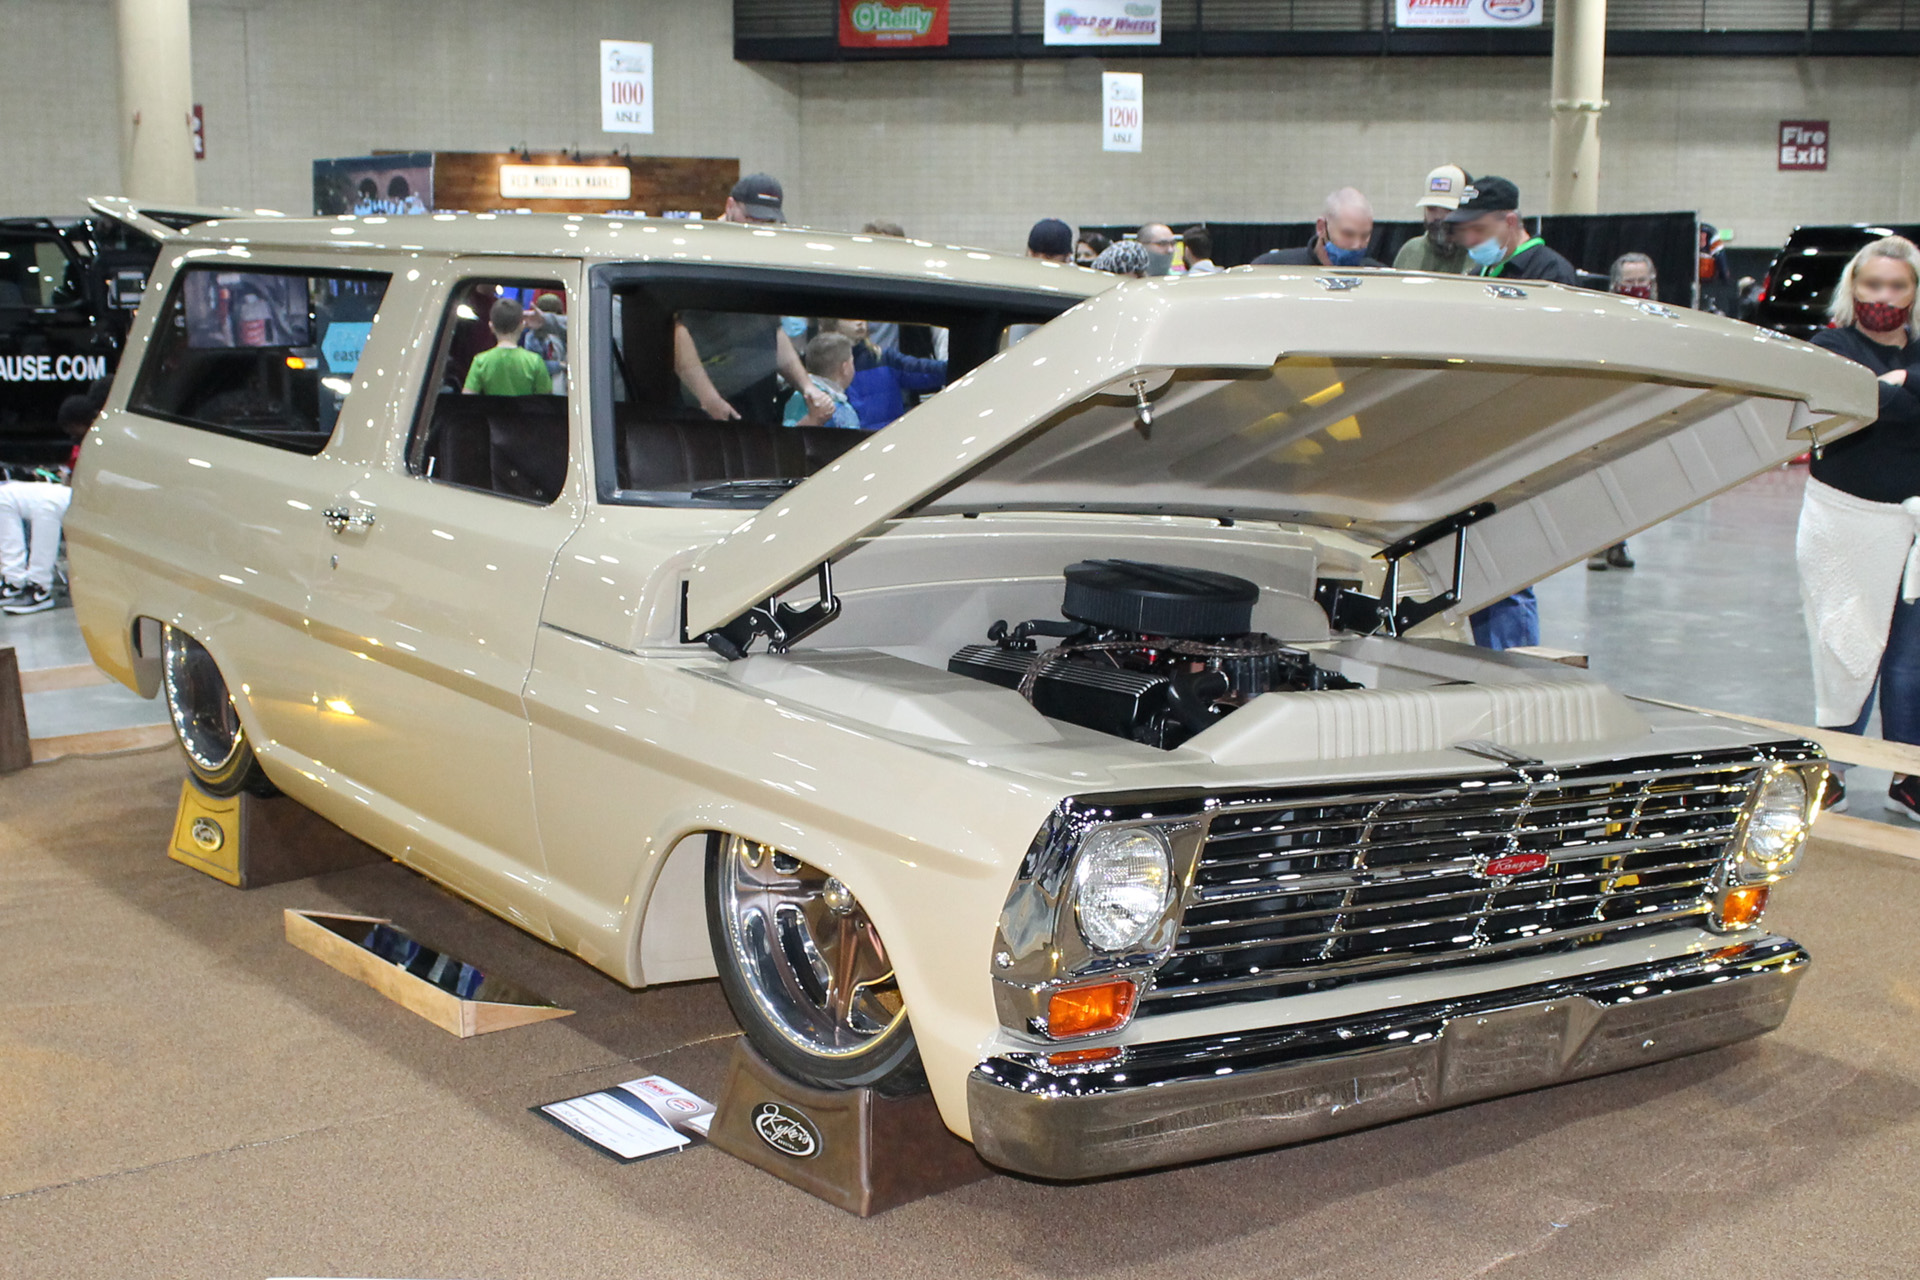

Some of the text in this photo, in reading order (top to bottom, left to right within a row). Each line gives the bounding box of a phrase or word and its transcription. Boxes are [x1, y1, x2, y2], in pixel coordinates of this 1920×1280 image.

[853, 2, 934, 34] O'Reilly
[611, 81, 644, 106] 1100
[1109, 105, 1138, 129] 1200
[1782, 127, 1826, 145] Fire
[1781, 146, 1826, 165] Exit
[1488, 858, 1543, 872] Ranger
